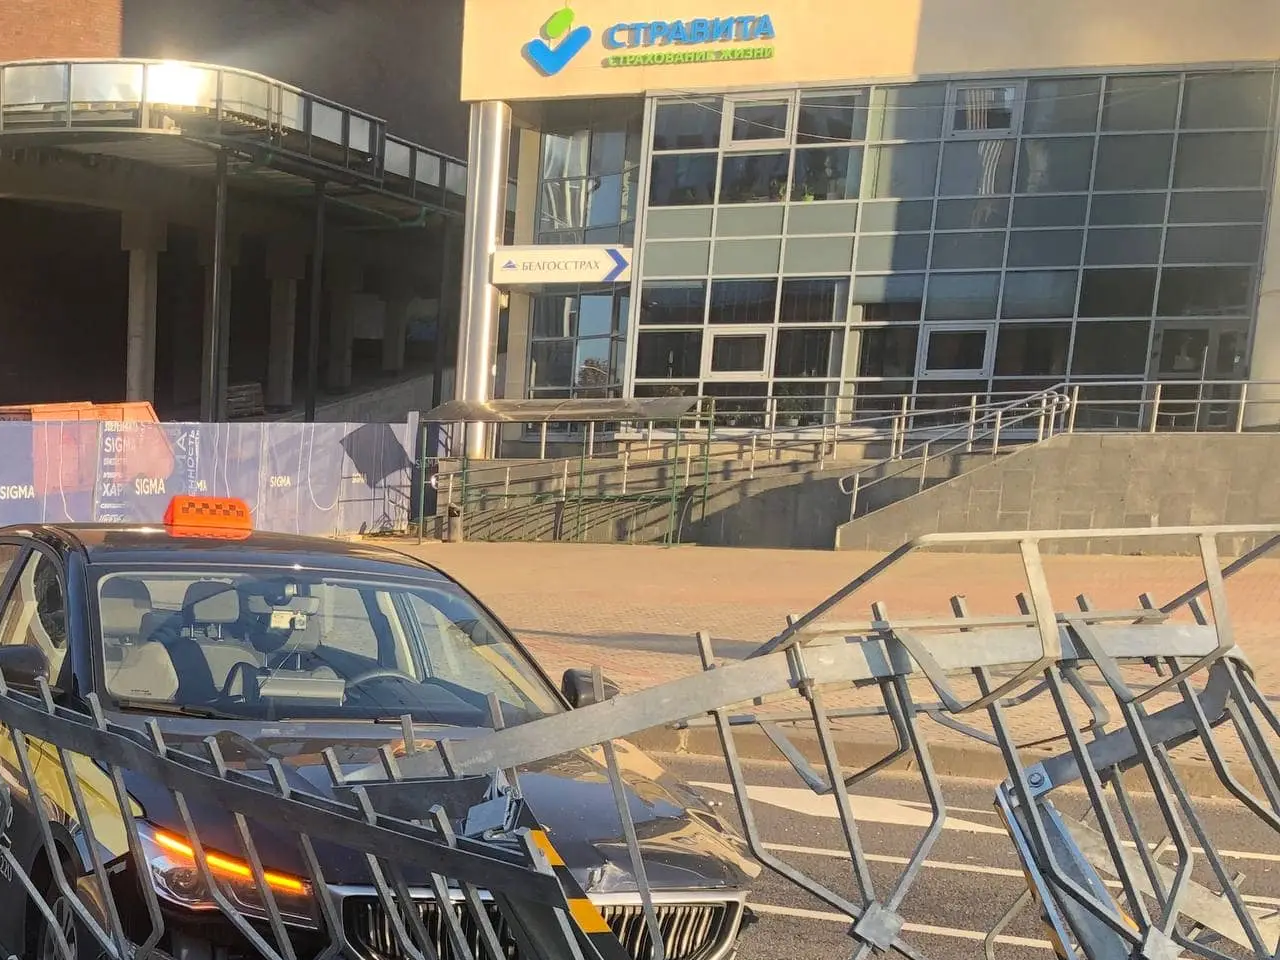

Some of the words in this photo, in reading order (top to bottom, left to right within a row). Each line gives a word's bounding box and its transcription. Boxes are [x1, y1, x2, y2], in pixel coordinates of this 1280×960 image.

[606, 14, 775, 49] СТРАВИТА
[606, 50, 715, 67] СТРАХОВАНИЕ
[720, 47, 774, 61] ЖИЗНИ
[522, 260, 600, 272] БЕЛГОССТРАХ
[135, 478, 165, 496] SIGMA
[270, 475, 291, 488] SIGMA
[0, 485, 35, 500] SIGMA
